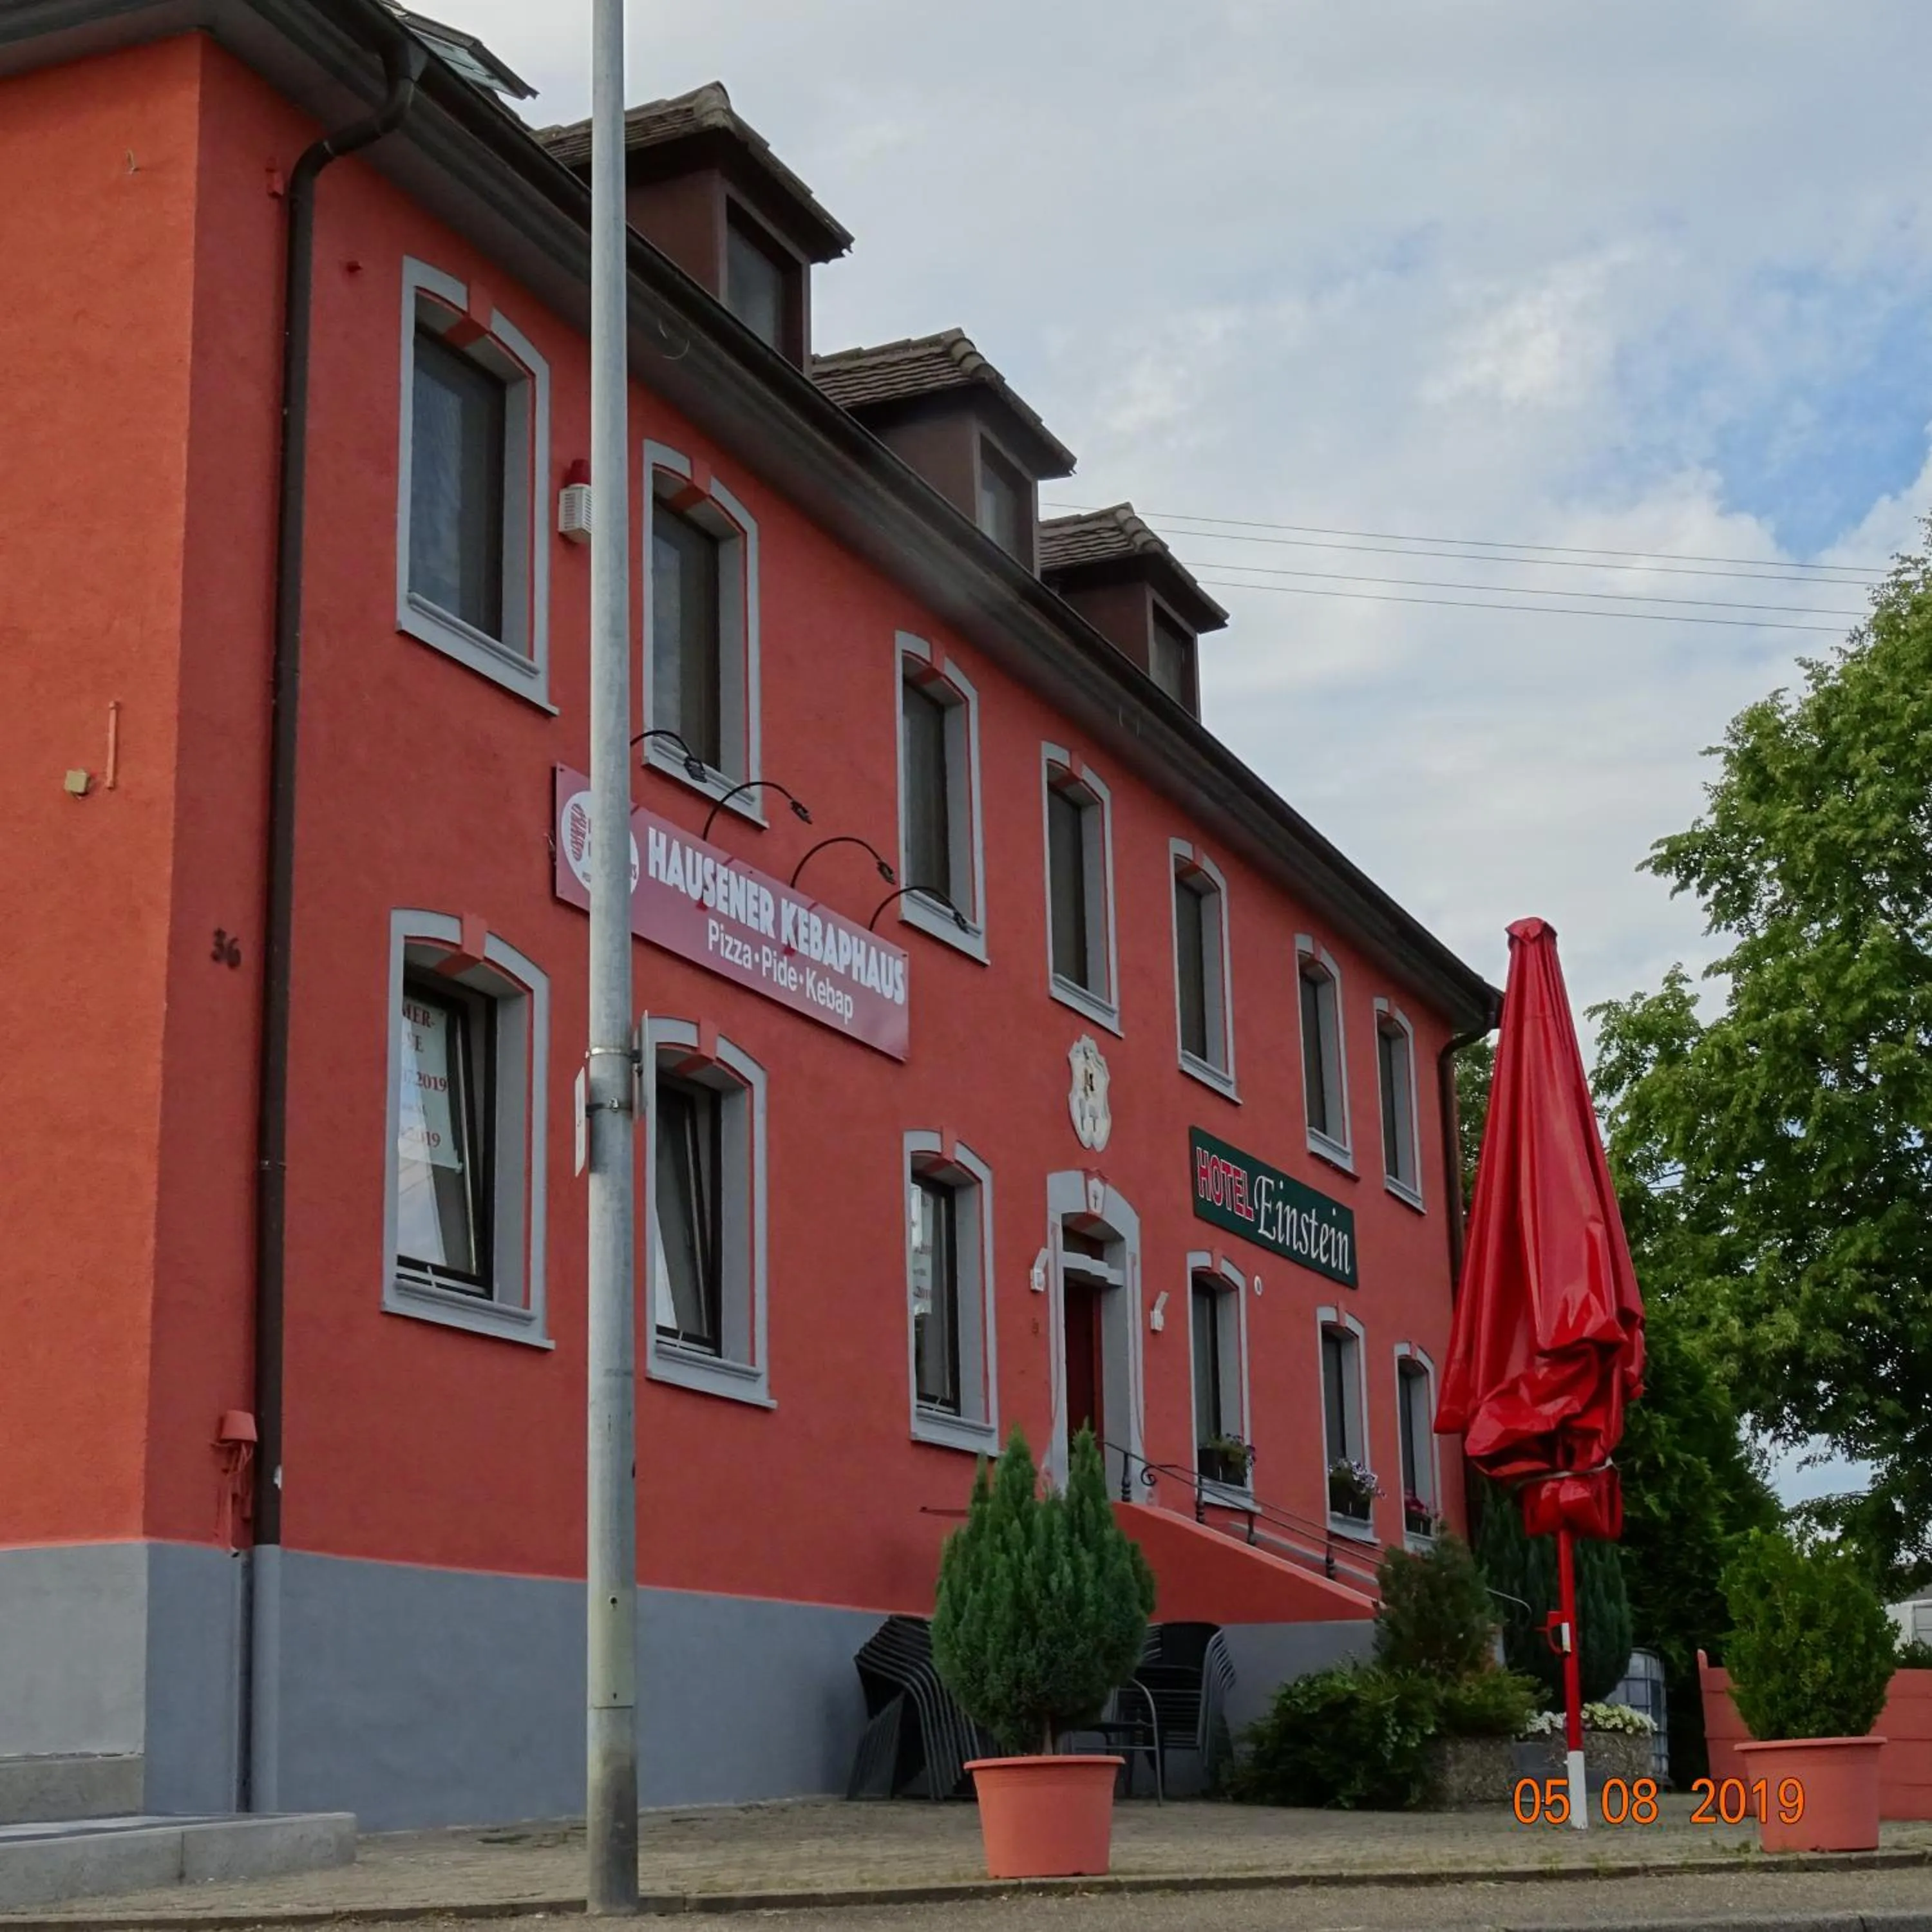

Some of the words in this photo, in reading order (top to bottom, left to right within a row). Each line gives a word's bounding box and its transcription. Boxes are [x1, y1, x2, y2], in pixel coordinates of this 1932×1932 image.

[211, 927, 241, 970] 36
[649, 827, 775, 939] HAUSENER
[781, 898, 905, 1005] KEBAPHAUS
[708, 918, 753, 970] Pizza
[762, 945, 797, 991] Pide
[806, 967, 853, 1025] Kebap
[1197, 1146, 1254, 1222] HOTEL
[1254, 1175, 1350, 1274] Einstein
